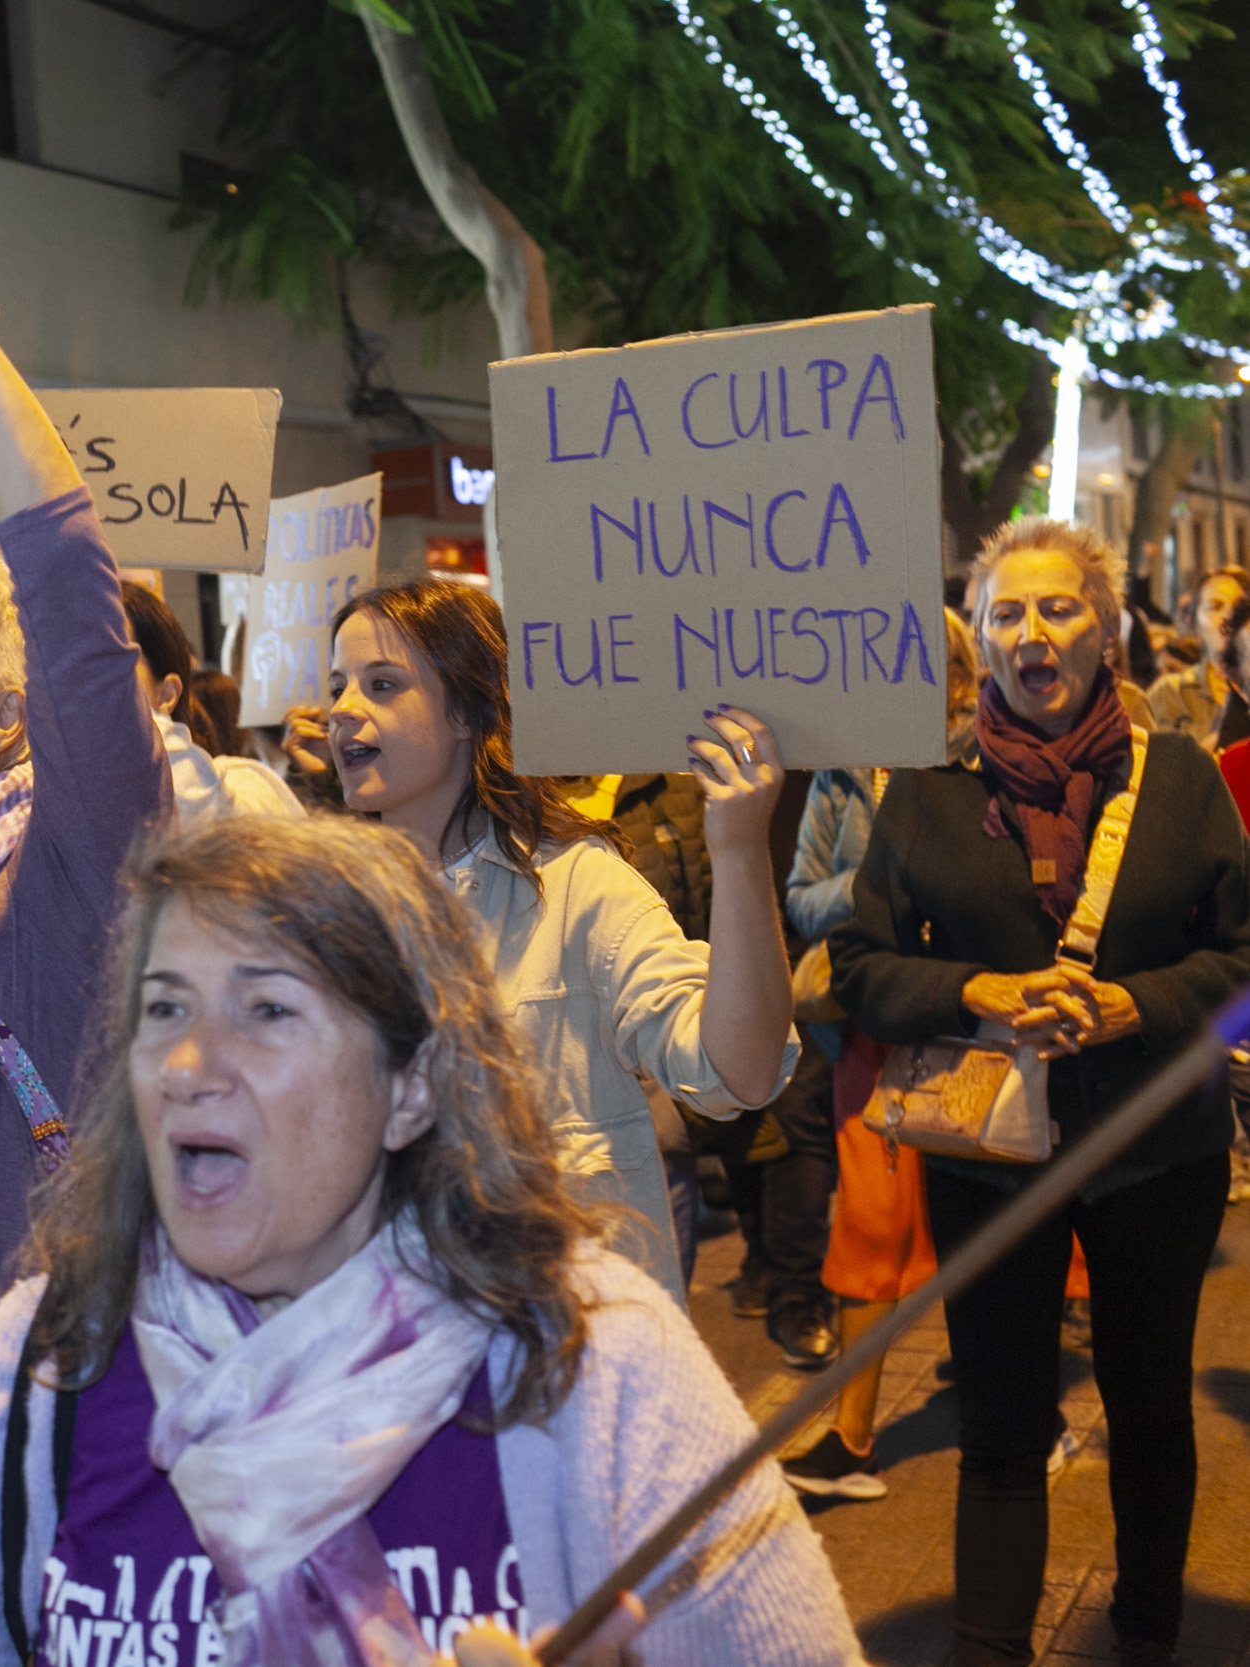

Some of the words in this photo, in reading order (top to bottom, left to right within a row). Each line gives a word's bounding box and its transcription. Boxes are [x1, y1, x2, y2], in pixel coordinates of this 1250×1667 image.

[546, 378, 650, 463] LA
[681, 354, 905, 449] CULPA
[102, 477, 250, 551] SOLA
[590, 483, 871, 582] NUNCA
[522, 614, 640, 690] FUE
[674, 600, 937, 692] NUESTRA
